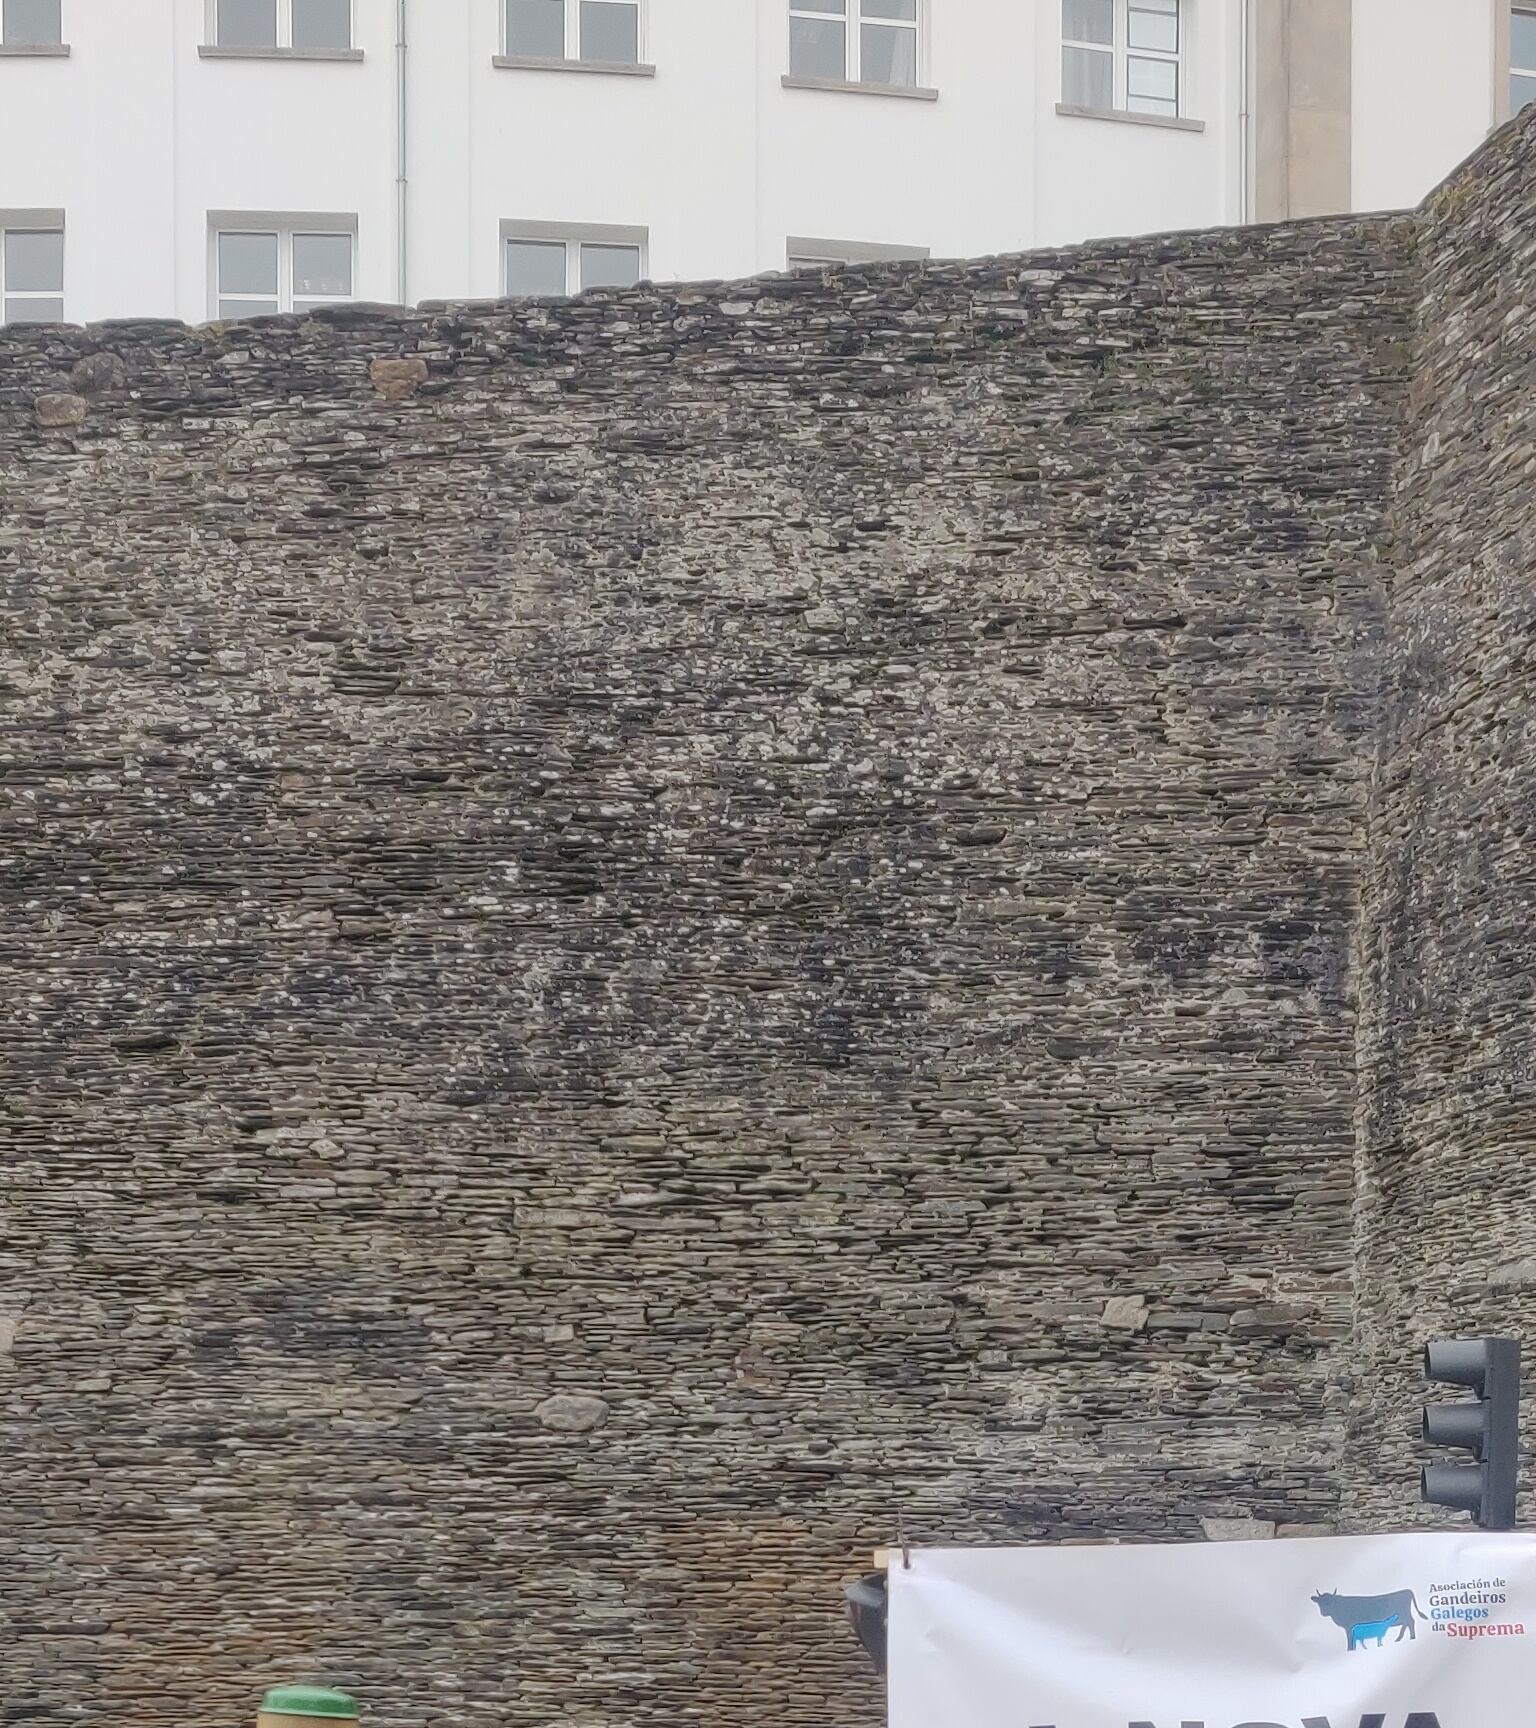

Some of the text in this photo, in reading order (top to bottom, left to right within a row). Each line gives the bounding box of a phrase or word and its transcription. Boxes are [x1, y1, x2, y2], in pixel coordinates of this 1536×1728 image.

[1429, 1577, 1506, 1593] Asociación de
[1429, 1590, 1506, 1607] Gandeiros
[1430, 1605, 1489, 1621] Galegos
[1432, 1620, 1525, 1640] da Suprema
